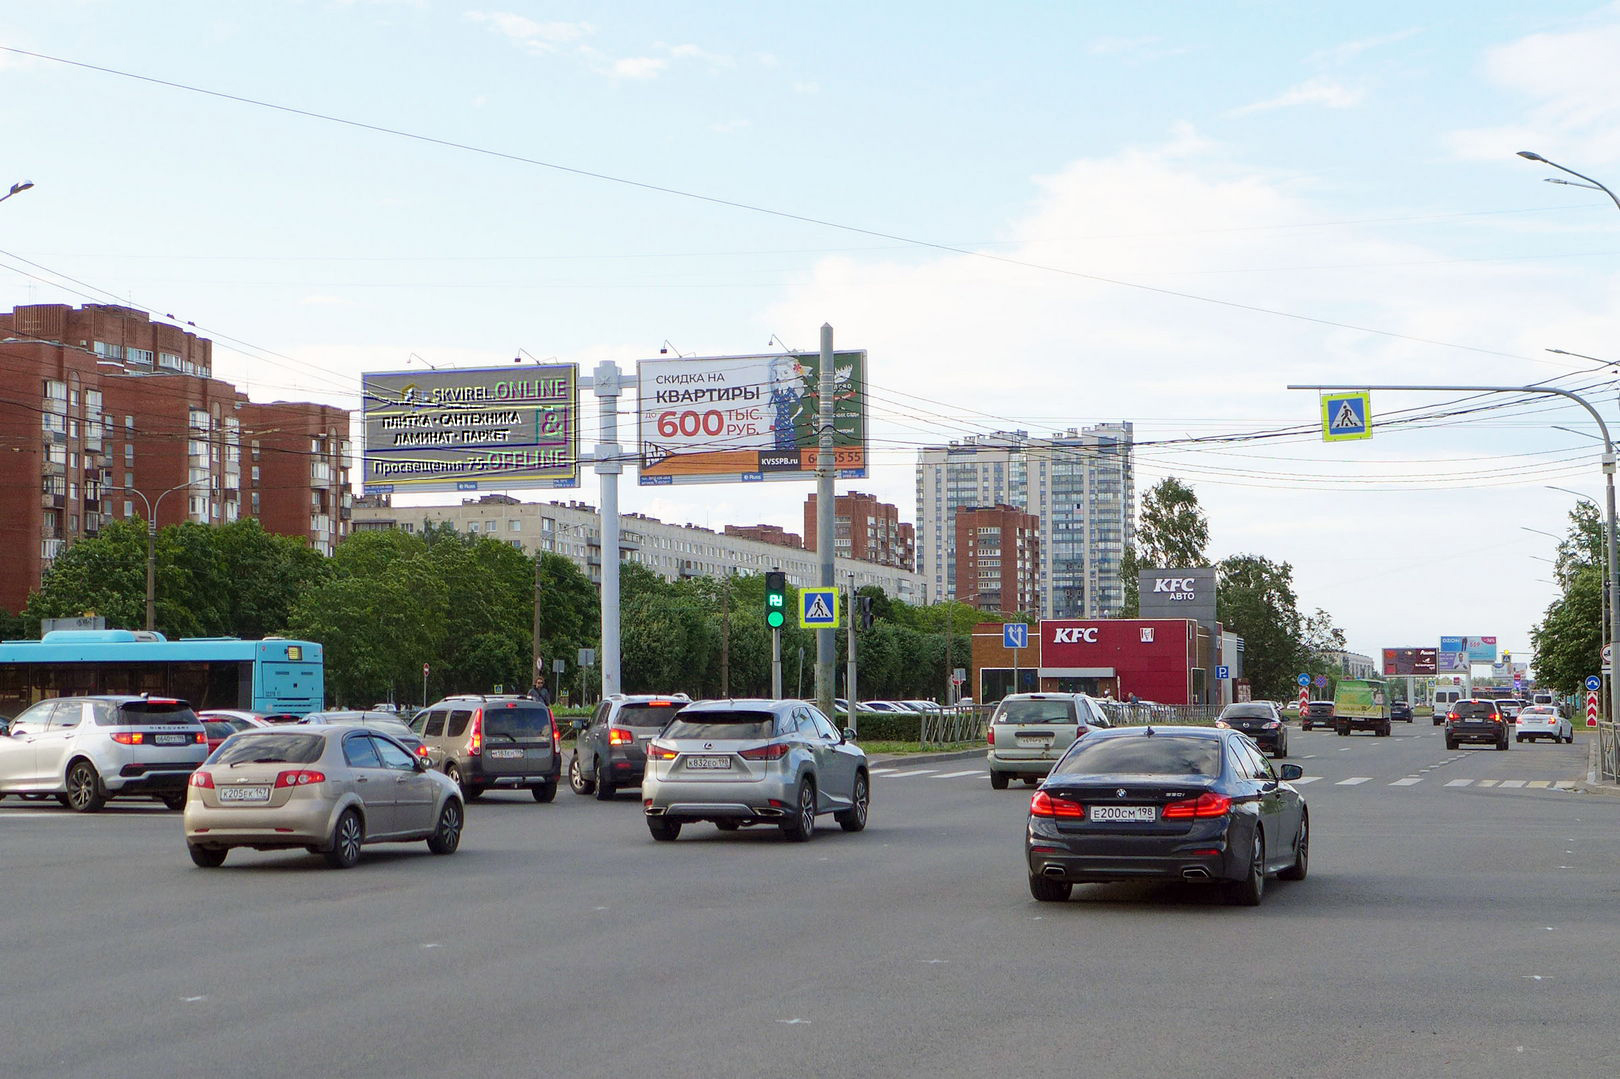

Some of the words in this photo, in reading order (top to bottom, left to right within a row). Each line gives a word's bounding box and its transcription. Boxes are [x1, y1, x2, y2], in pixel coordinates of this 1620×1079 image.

[656, 374, 705, 385] СКИДКА
[708, 373, 725, 382] НА
[656, 386, 760, 403] КВАРТИРЫ
[382, 414, 433, 430] ПЛИТКА
[440, 411, 522, 428] САНТЕХНИКА
[727, 408, 763, 421] ТЫС.
[657, 409, 725, 438] 600
[727, 423, 760, 436] РУБ.
[394, 431, 455, 446] ЛАМИНАТ
[462, 429, 511, 443] ПАРКЕТ
[761, 457, 799, 465] KVSSPB.ru
[1153, 578, 1195, 593] KFC
[1169, 592, 1195, 601] АВТО
[1053, 628, 1099, 643] KFC
[1138, 807, 1154, 816] 198
